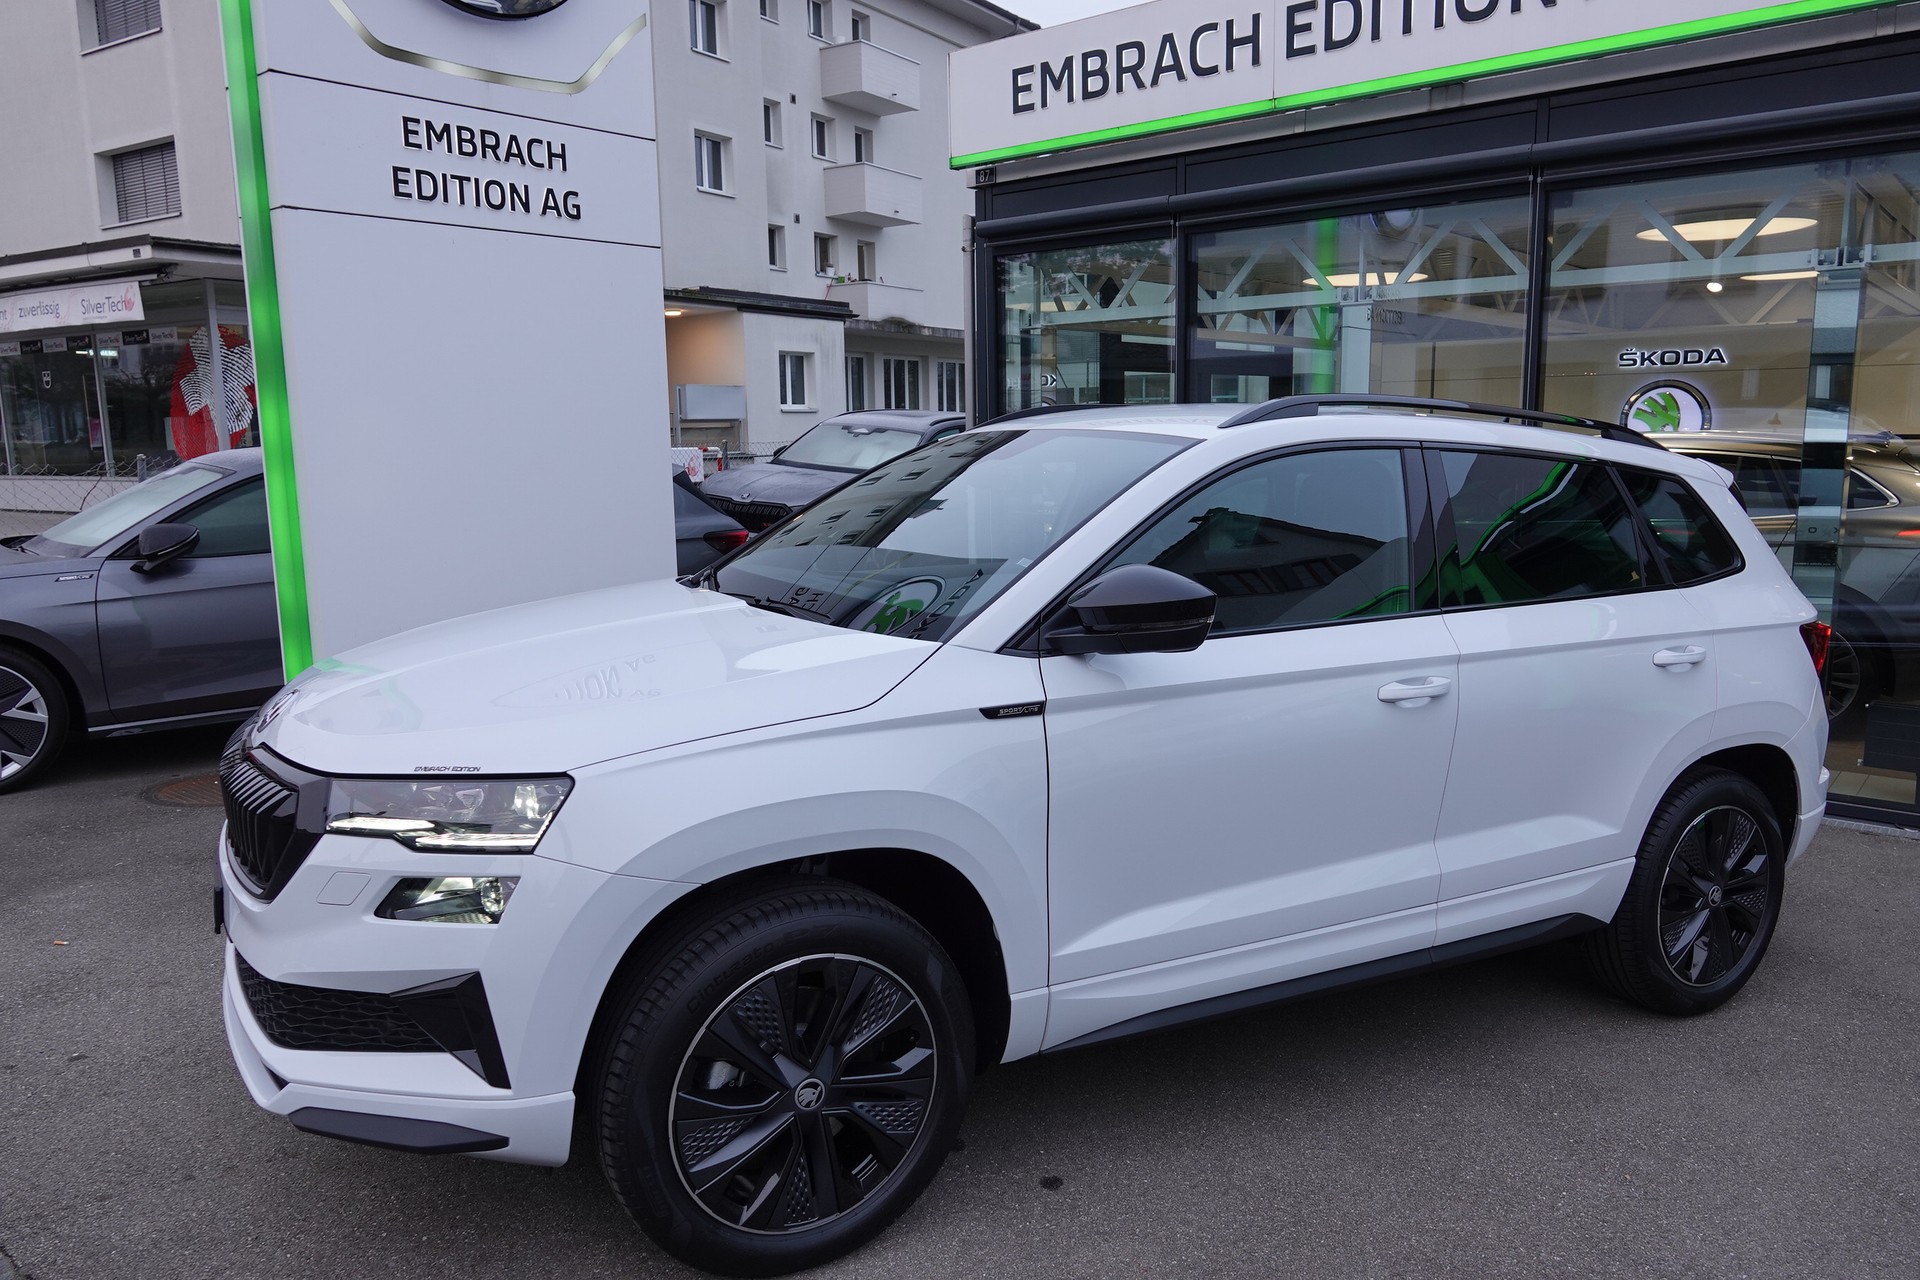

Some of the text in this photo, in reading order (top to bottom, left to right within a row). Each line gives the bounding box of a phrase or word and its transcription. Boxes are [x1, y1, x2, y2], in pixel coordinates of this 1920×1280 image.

[1012, 13, 1261, 115] EMBRACH
[401, 115, 567, 172] EMBRACH
[391, 165, 581, 220] EDITION AG
[980, 170, 990, 182] 87
[18, 301, 60, 319] zuverlässig
[81, 295, 128, 315] SilverTech
[1619, 347, 1727, 367] ŠKODA
